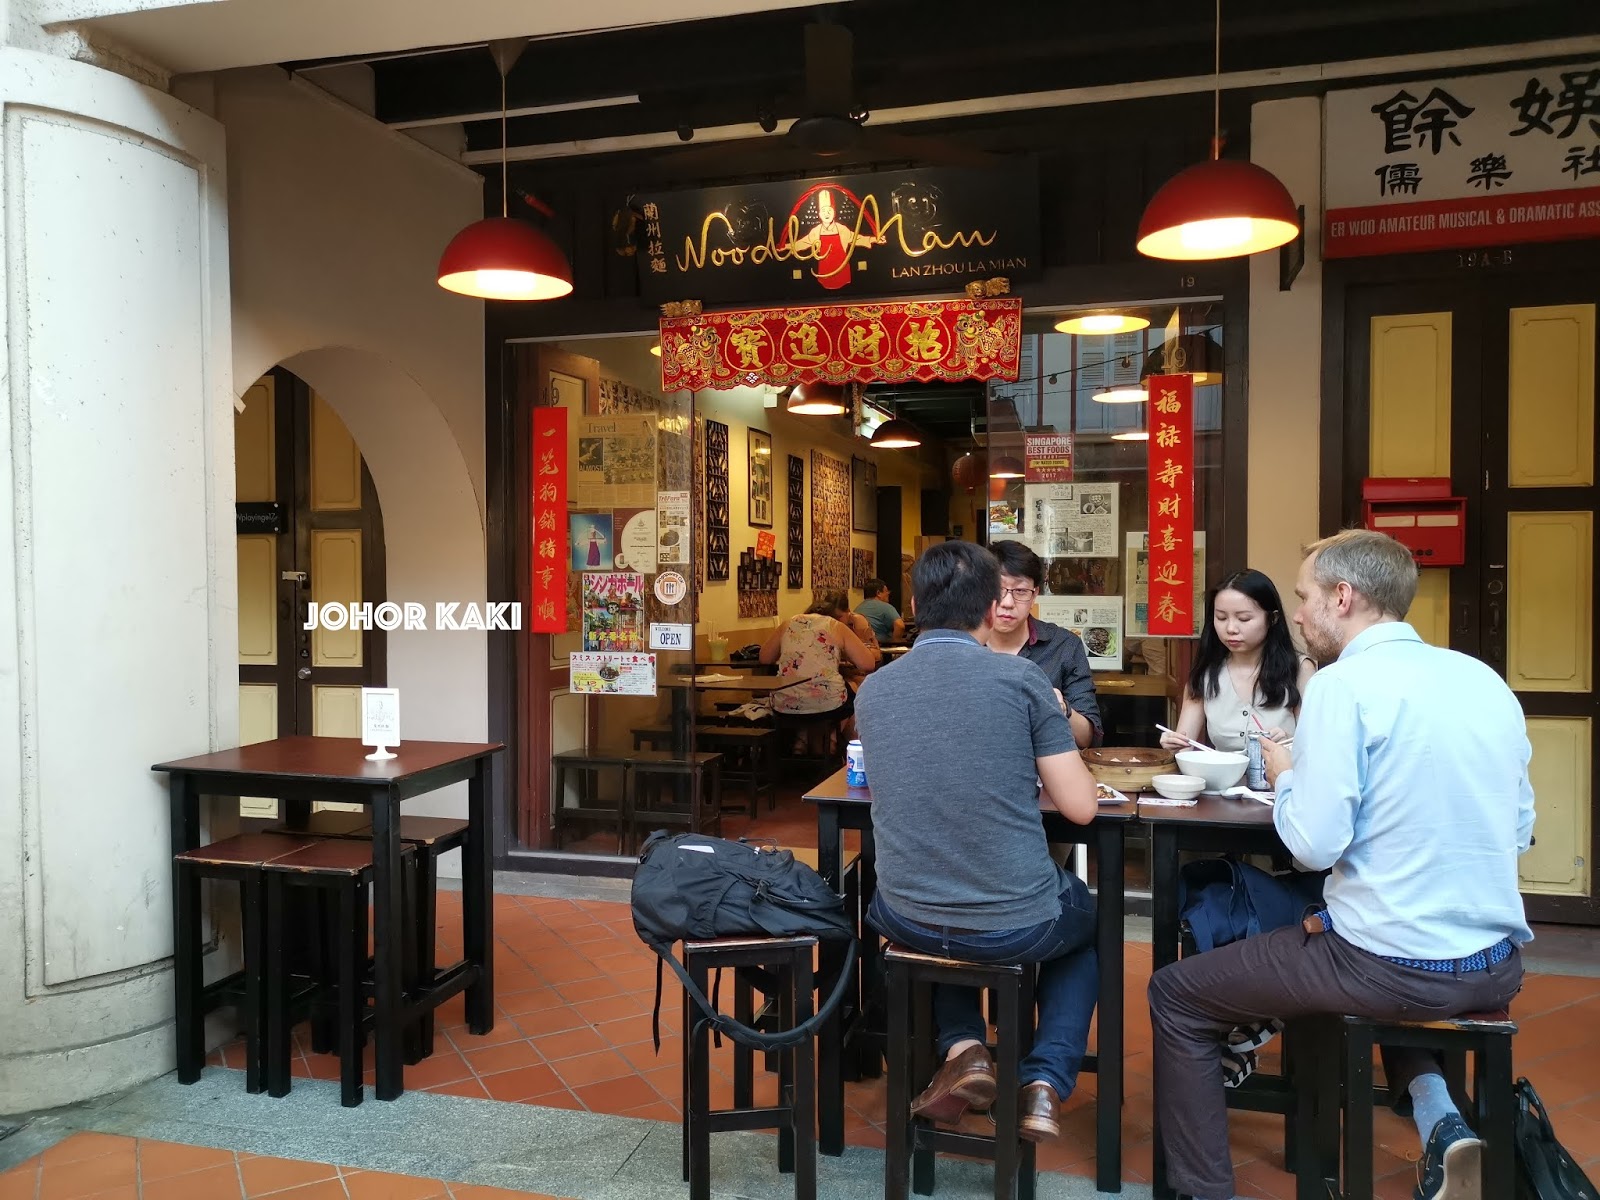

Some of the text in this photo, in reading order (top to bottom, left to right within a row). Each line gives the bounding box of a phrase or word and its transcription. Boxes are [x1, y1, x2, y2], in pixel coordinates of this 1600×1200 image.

[1331, 222, 1345, 237] ER
[1349, 219, 1375, 236] WOO
[1379, 214, 1435, 233] AMATEUR
[1439, 209, 1492, 229] MUSICAL
[1496, 208, 1505, 225] &
[1509, 202, 1574, 224] DRAMATIC
[676, 194, 998, 278] Noodle Man
[892, 257, 1027, 279] LAN ZHOU LA MIAN
[1181, 276, 1195, 288] 19
[587, 422, 616, 433] Travel
[1027, 437, 1071, 446] SINGAPORE
[1047, 446, 1070, 454] FOODS
[660, 632, 681, 645] OPEN
